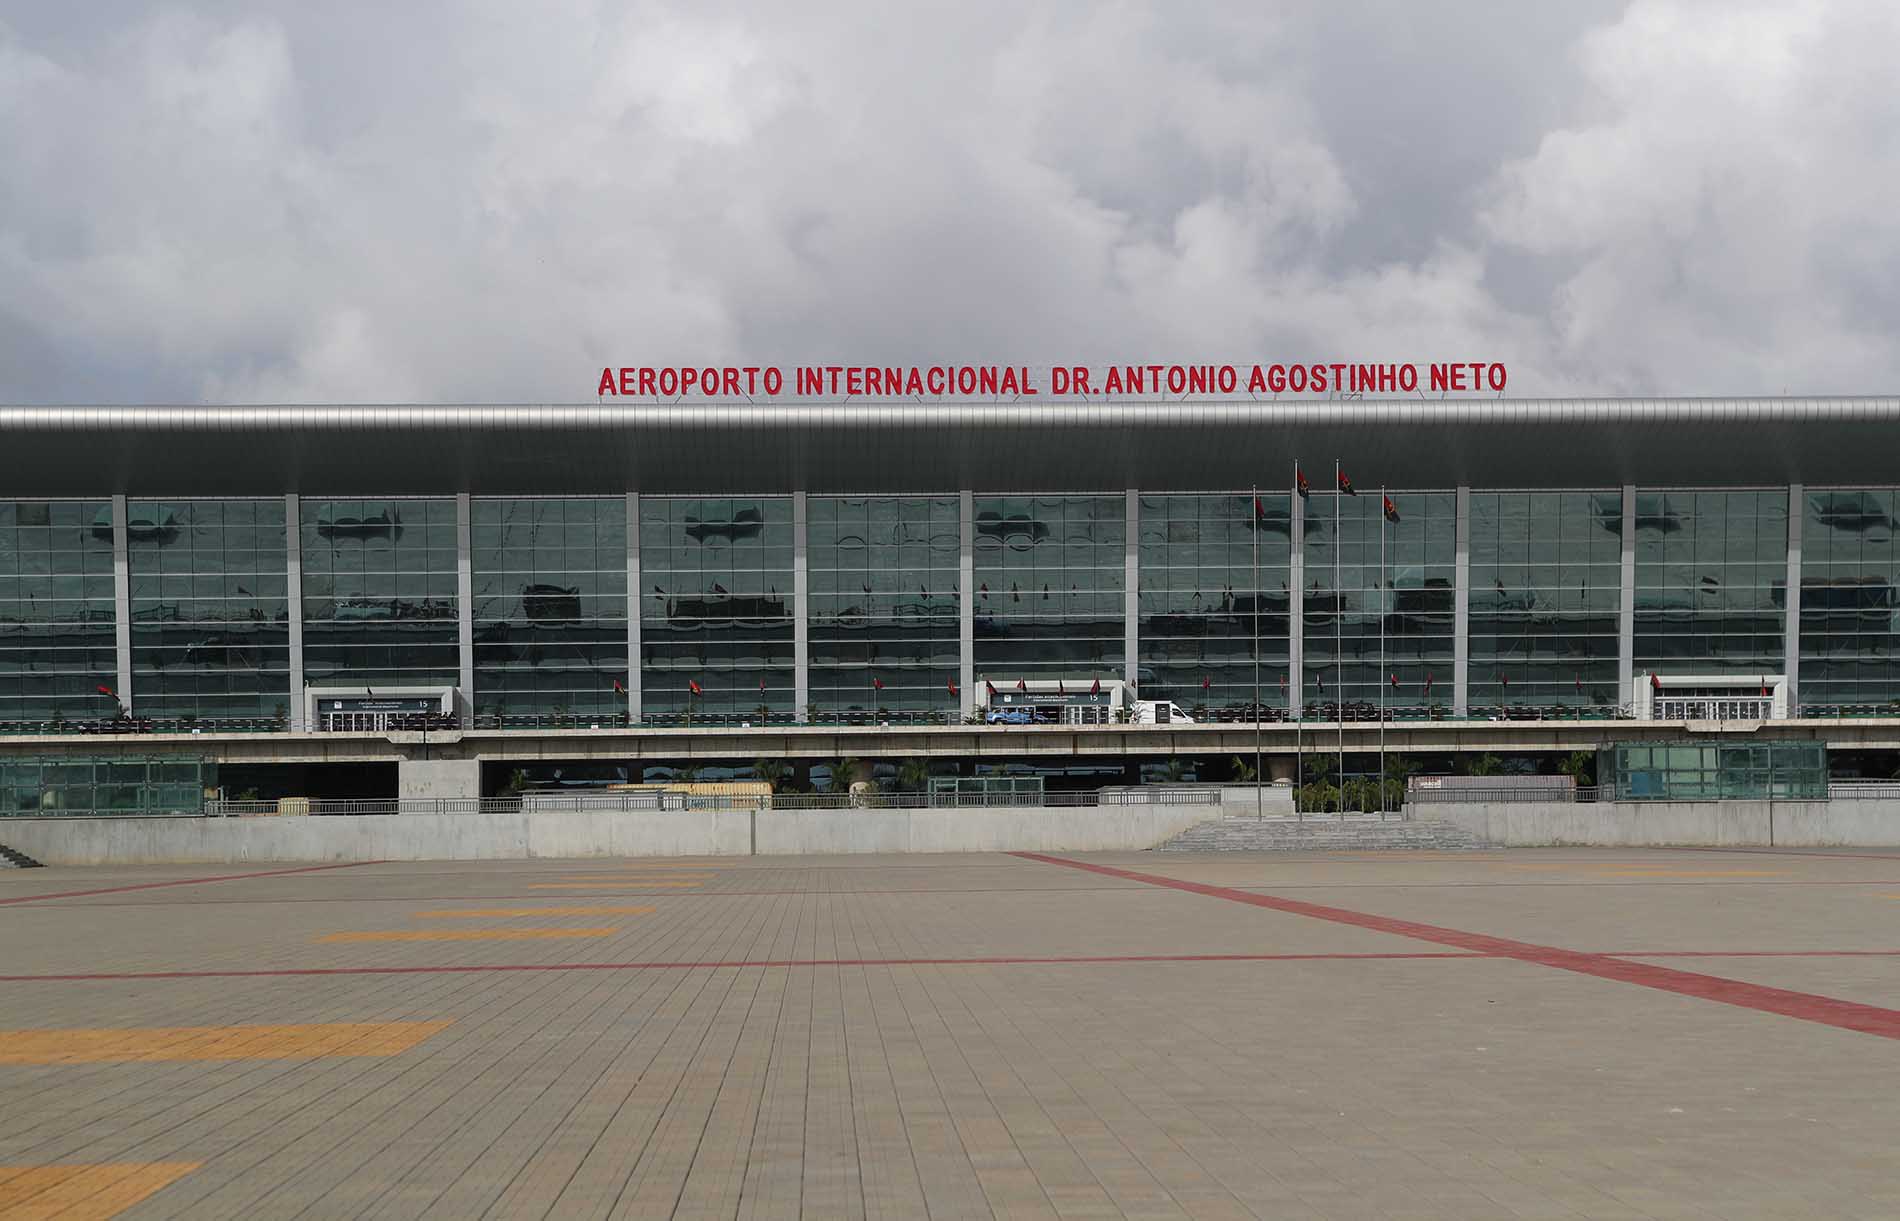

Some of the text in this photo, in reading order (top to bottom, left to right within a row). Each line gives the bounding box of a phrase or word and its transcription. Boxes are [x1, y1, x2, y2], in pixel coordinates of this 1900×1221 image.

[598, 367, 783, 396] AEROPORTO
[796, 366, 1038, 396] INTERNACIONAL
[1248, 363, 1418, 393] AGOSTINHO
[1430, 362, 1507, 392] NETO
[1089, 694, 1098, 702] 15
[419, 700, 428, 708] 15
